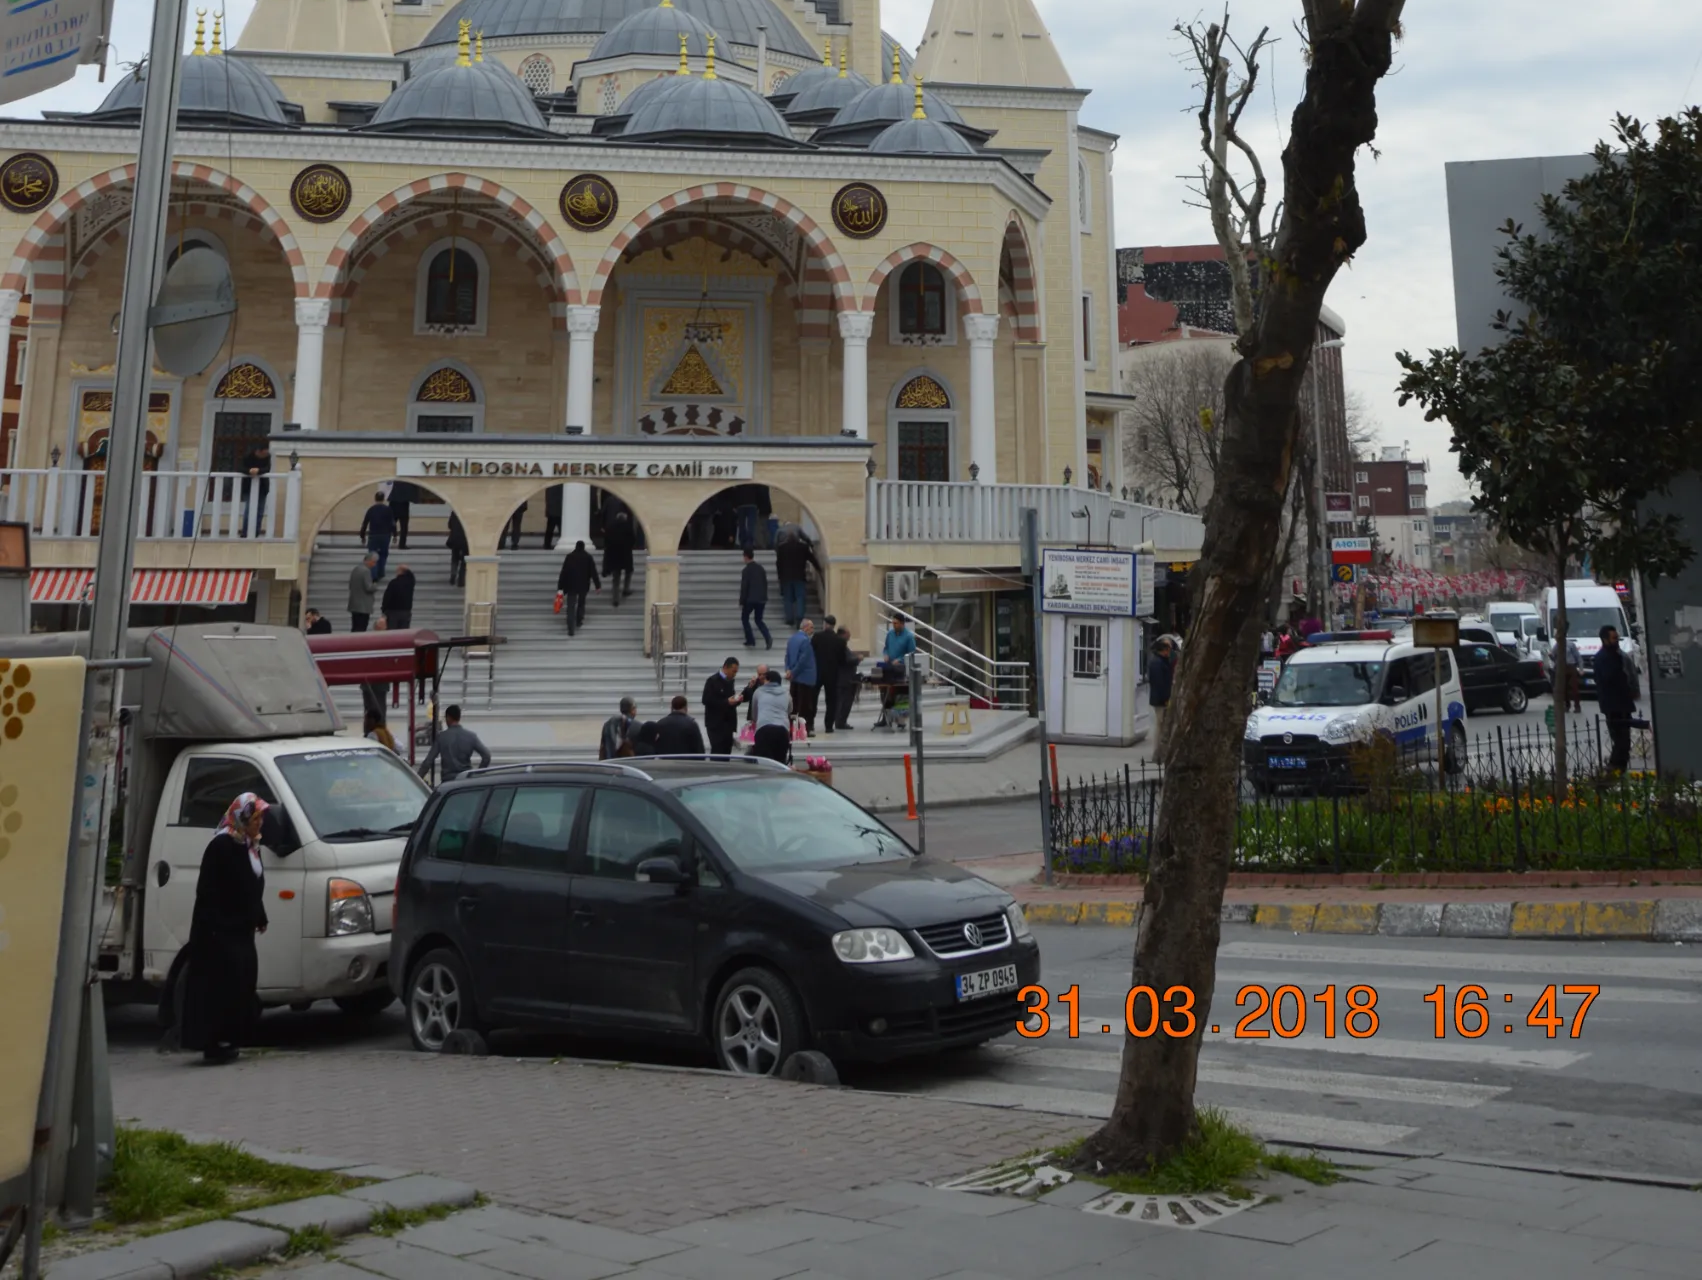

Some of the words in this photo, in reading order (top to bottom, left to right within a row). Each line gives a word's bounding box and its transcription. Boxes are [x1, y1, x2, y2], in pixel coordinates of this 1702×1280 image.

[421, 458, 544, 476] YENİBOSNA
[553, 462, 639, 477] MERKEZ
[646, 460, 702, 478] CAMİİ
[708, 464, 738, 476] 2017
[962, 975, 975, 994] 34
[978, 972, 990, 991] ZP
[992, 967, 1015, 988] 0945
